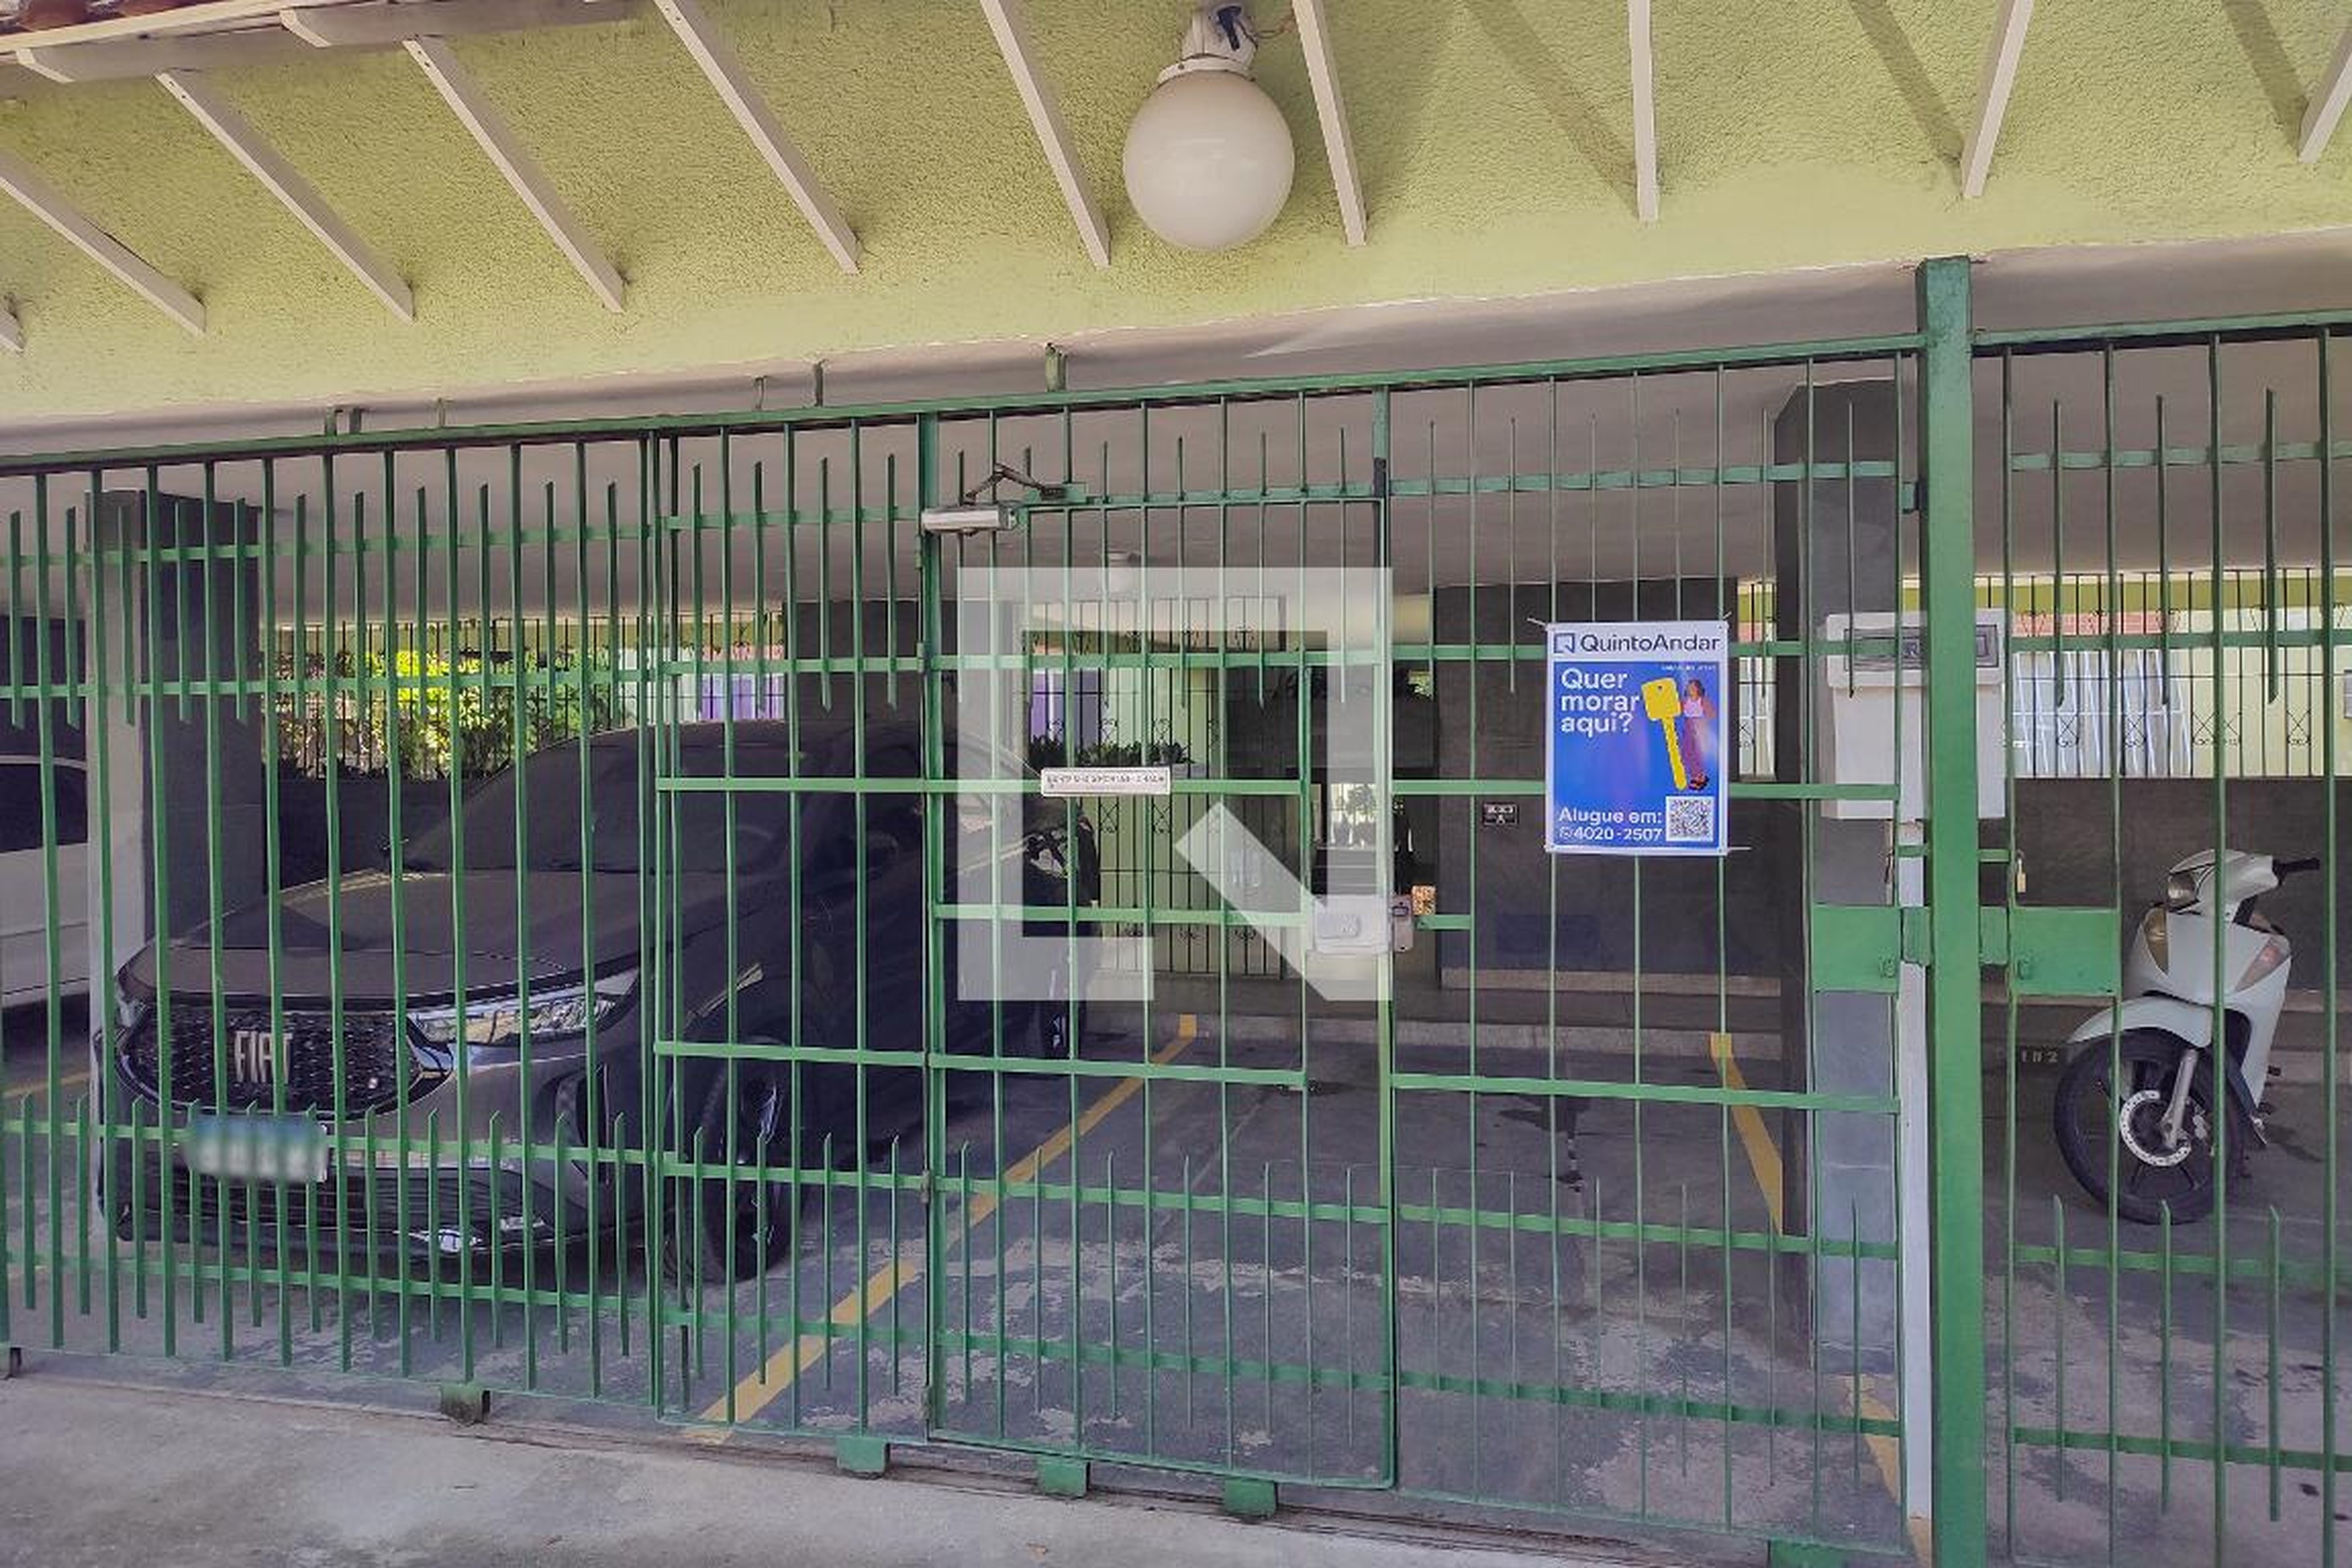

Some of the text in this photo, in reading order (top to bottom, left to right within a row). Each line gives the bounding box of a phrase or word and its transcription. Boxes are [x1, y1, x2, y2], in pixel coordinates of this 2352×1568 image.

[1580, 633, 1721, 652] QuintoAndar
[1561, 668, 1627, 690] Quer
[1561, 695, 1640, 712] morar
[1561, 712, 1634, 737] aqui?
[1559, 807, 1663, 826] Alugue em:
[234, 1030, 293, 1084] FIAT
